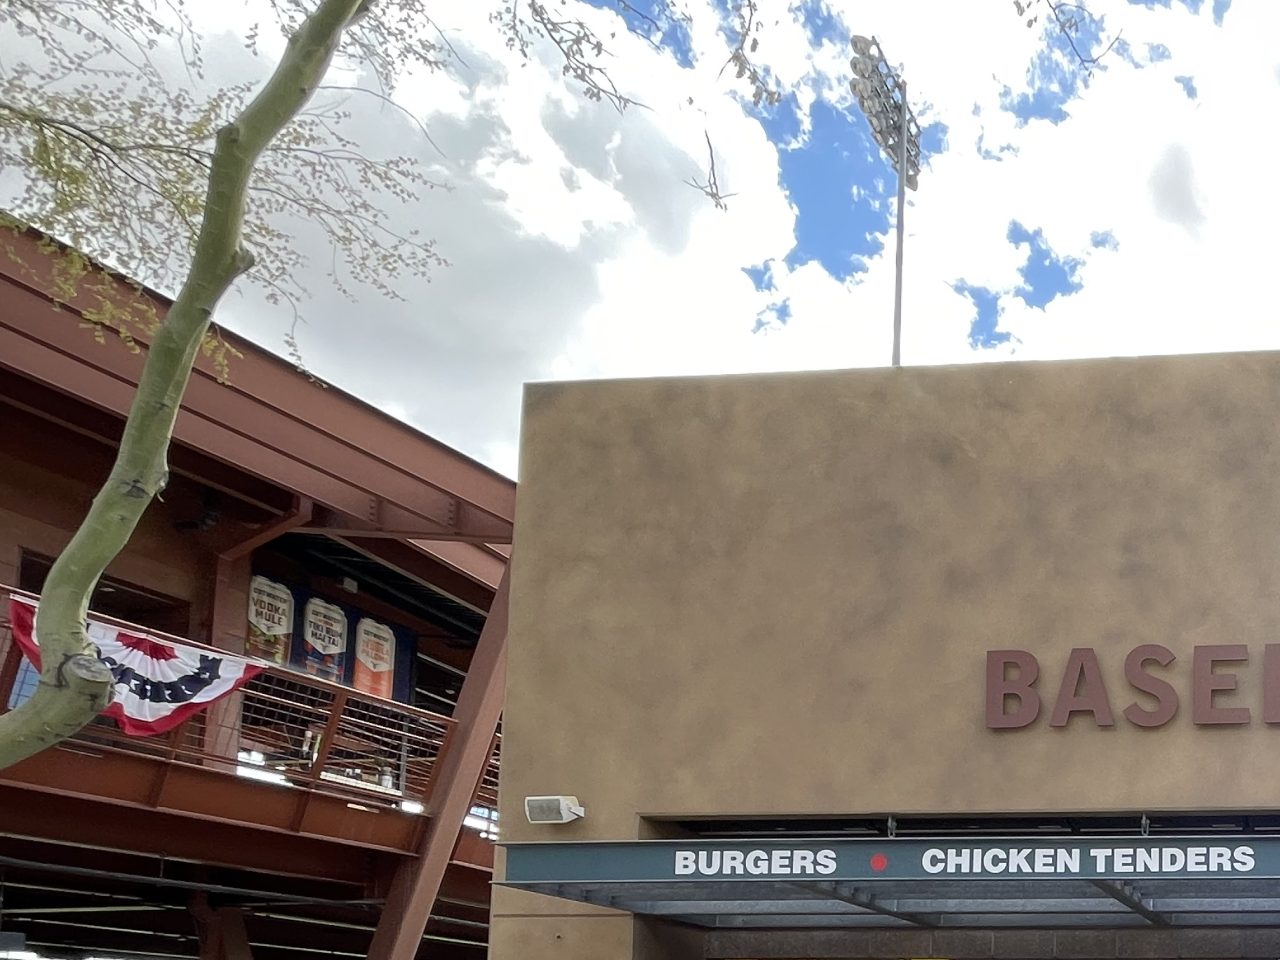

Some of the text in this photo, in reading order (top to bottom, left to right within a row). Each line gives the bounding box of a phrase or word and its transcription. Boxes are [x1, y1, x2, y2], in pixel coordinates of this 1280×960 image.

[252, 597, 287, 618] VODKA
[255, 609, 283, 626] MULE
[675, 849, 837, 875] BURGERS
[921, 846, 1256, 874] CHICKEN TENDERS
